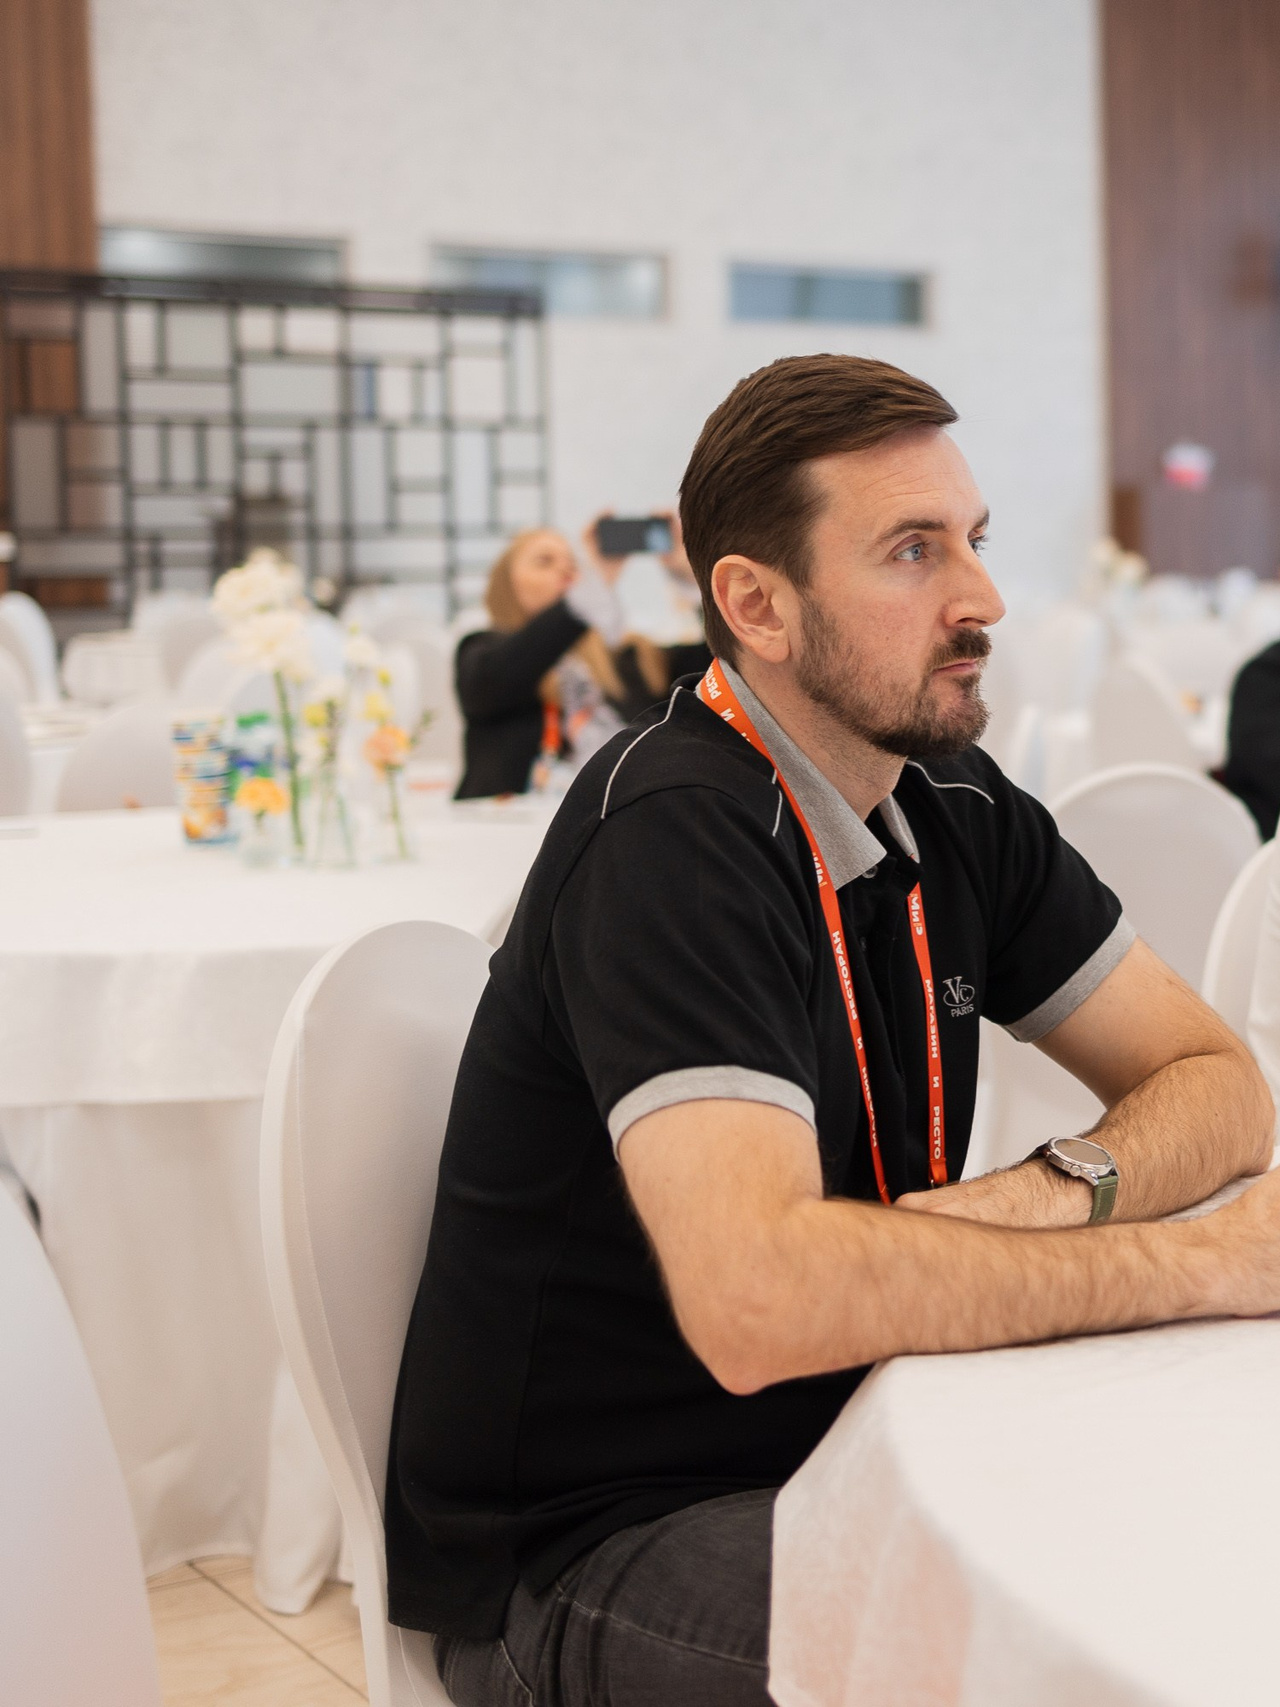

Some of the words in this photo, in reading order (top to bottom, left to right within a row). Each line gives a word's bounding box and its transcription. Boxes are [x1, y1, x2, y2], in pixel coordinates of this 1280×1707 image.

[720, 708, 735, 722] И
[832, 930, 858, 1020] РЕСТОРАН
[925, 979, 938, 1058] МАГАЗИН
[932, 1076, 940, 1088] И
[950, 1003, 975, 1017] PARIS
